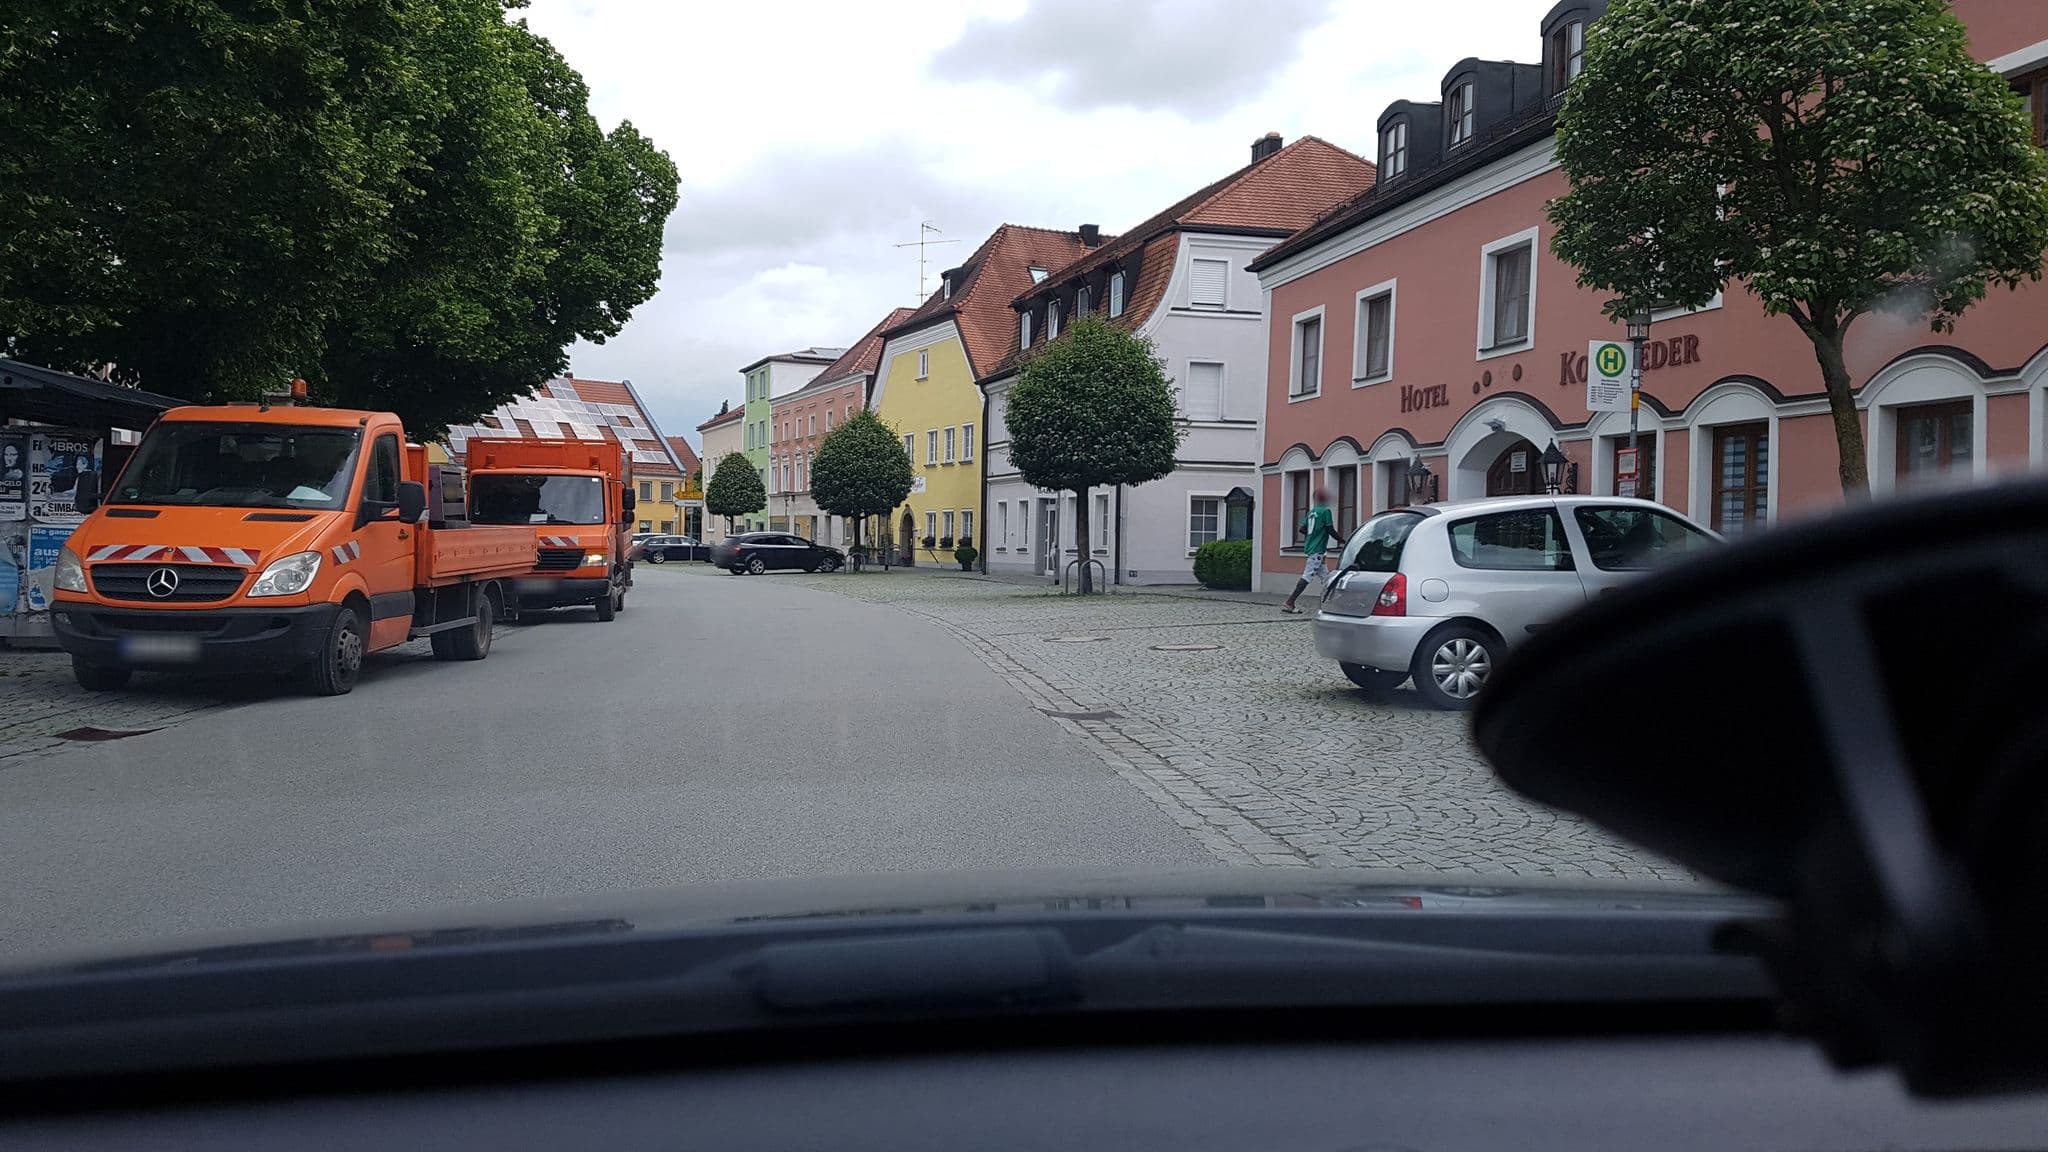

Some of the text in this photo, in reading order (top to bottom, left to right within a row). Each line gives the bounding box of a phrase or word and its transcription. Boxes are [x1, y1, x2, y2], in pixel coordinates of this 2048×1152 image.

[1604, 351, 1619, 370] H
[1400, 384, 1449, 413] HOTEL
[49, 441, 88, 452] MBROS
[48, 528, 73, 537] ganz
